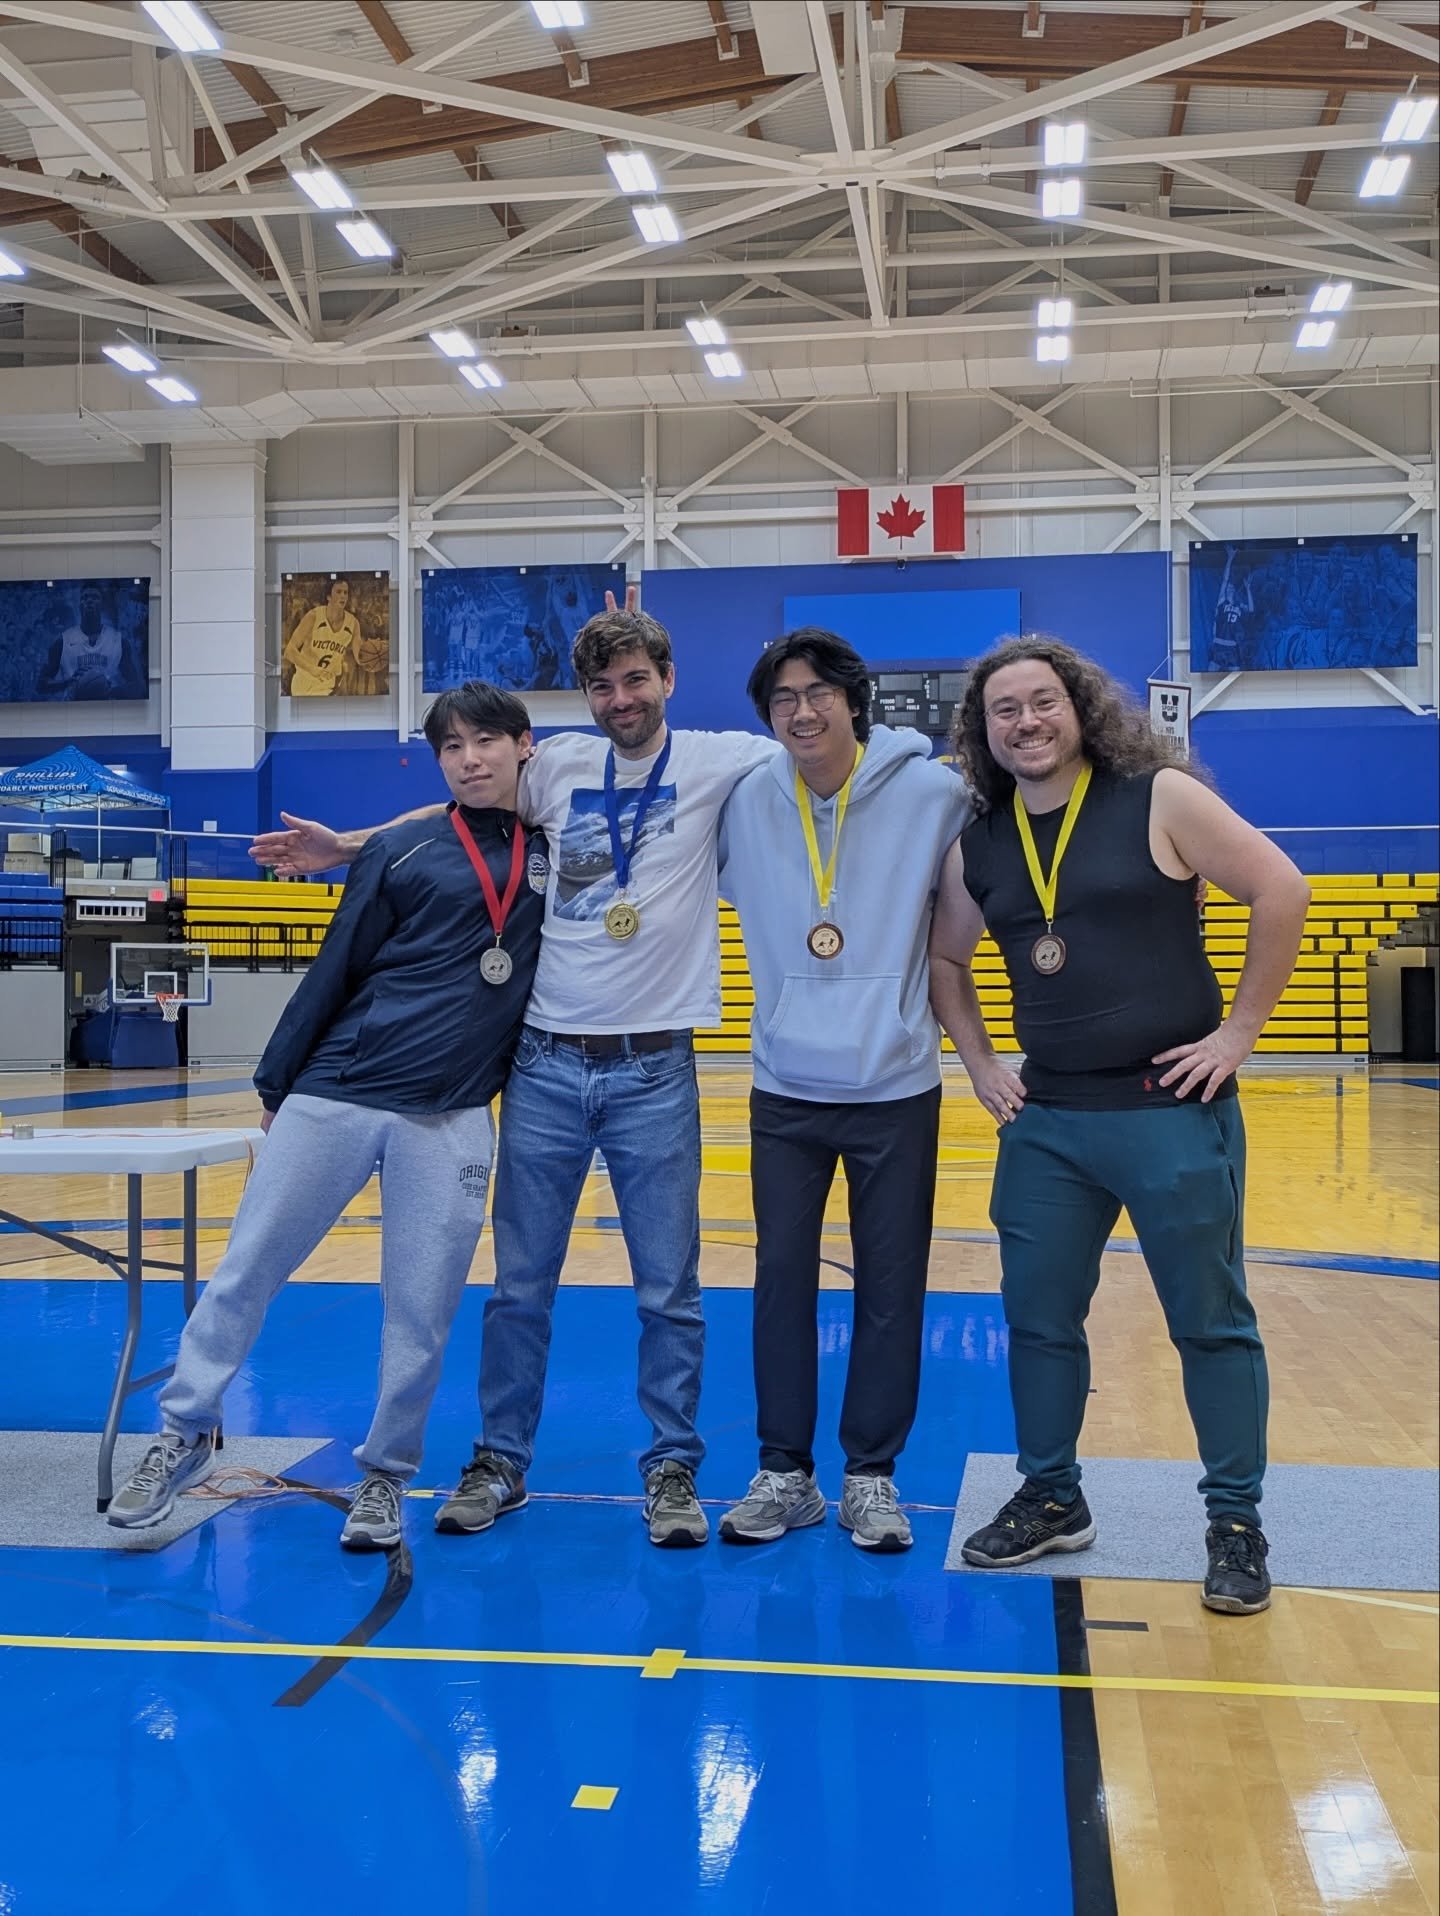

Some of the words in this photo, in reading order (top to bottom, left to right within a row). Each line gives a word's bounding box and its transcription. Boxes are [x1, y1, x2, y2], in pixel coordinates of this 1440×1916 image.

[1227, 612, 1238, 623] 13
[317, 654, 333, 669] 6
[1161, 705, 1178, 713] SPORTS
[15, 771, 77, 779] PHILLIPS
[0, 784, 27, 792] DABLY
[29, 783, 89, 792] INDEPENDENT
